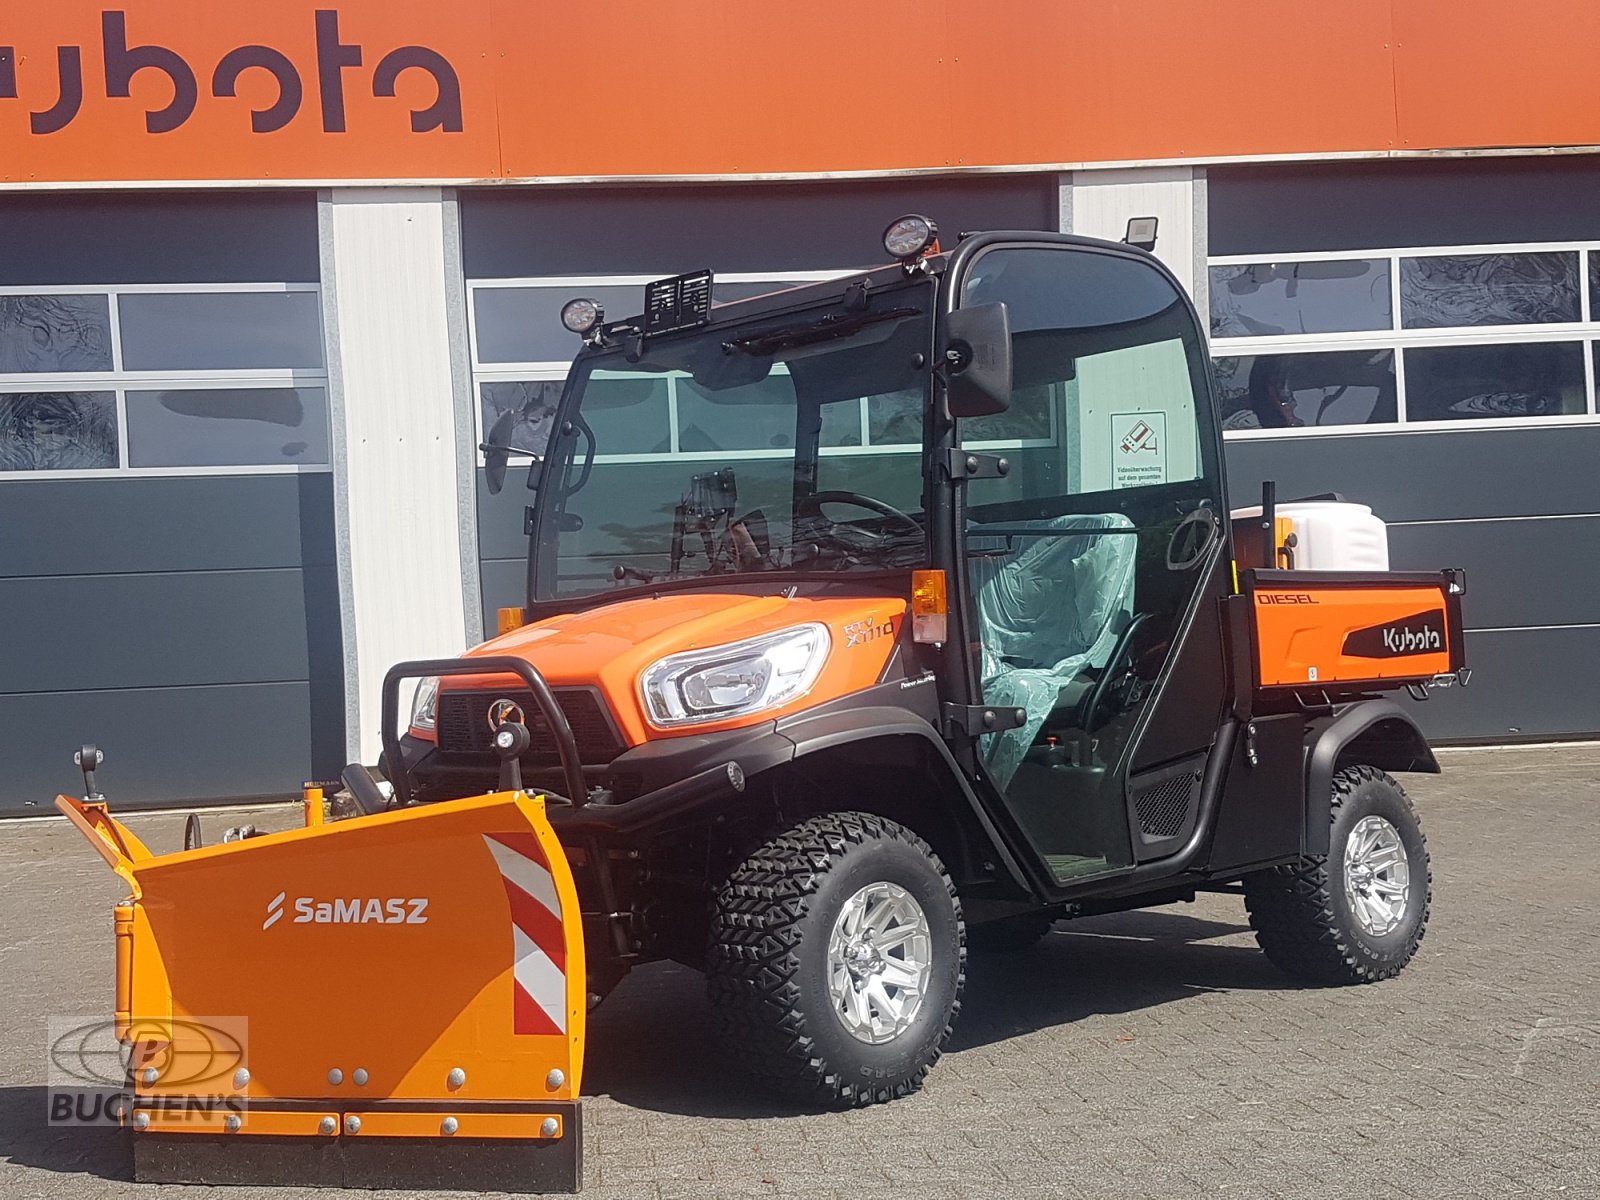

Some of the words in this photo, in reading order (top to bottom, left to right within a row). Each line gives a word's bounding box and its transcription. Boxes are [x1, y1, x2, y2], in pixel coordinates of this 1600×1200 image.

[1257, 594, 1320, 604] DIESEL
[844, 618, 873, 634] RTV
[1383, 625, 1440, 652] Kubota
[293, 897, 428, 924] SaMASZ
